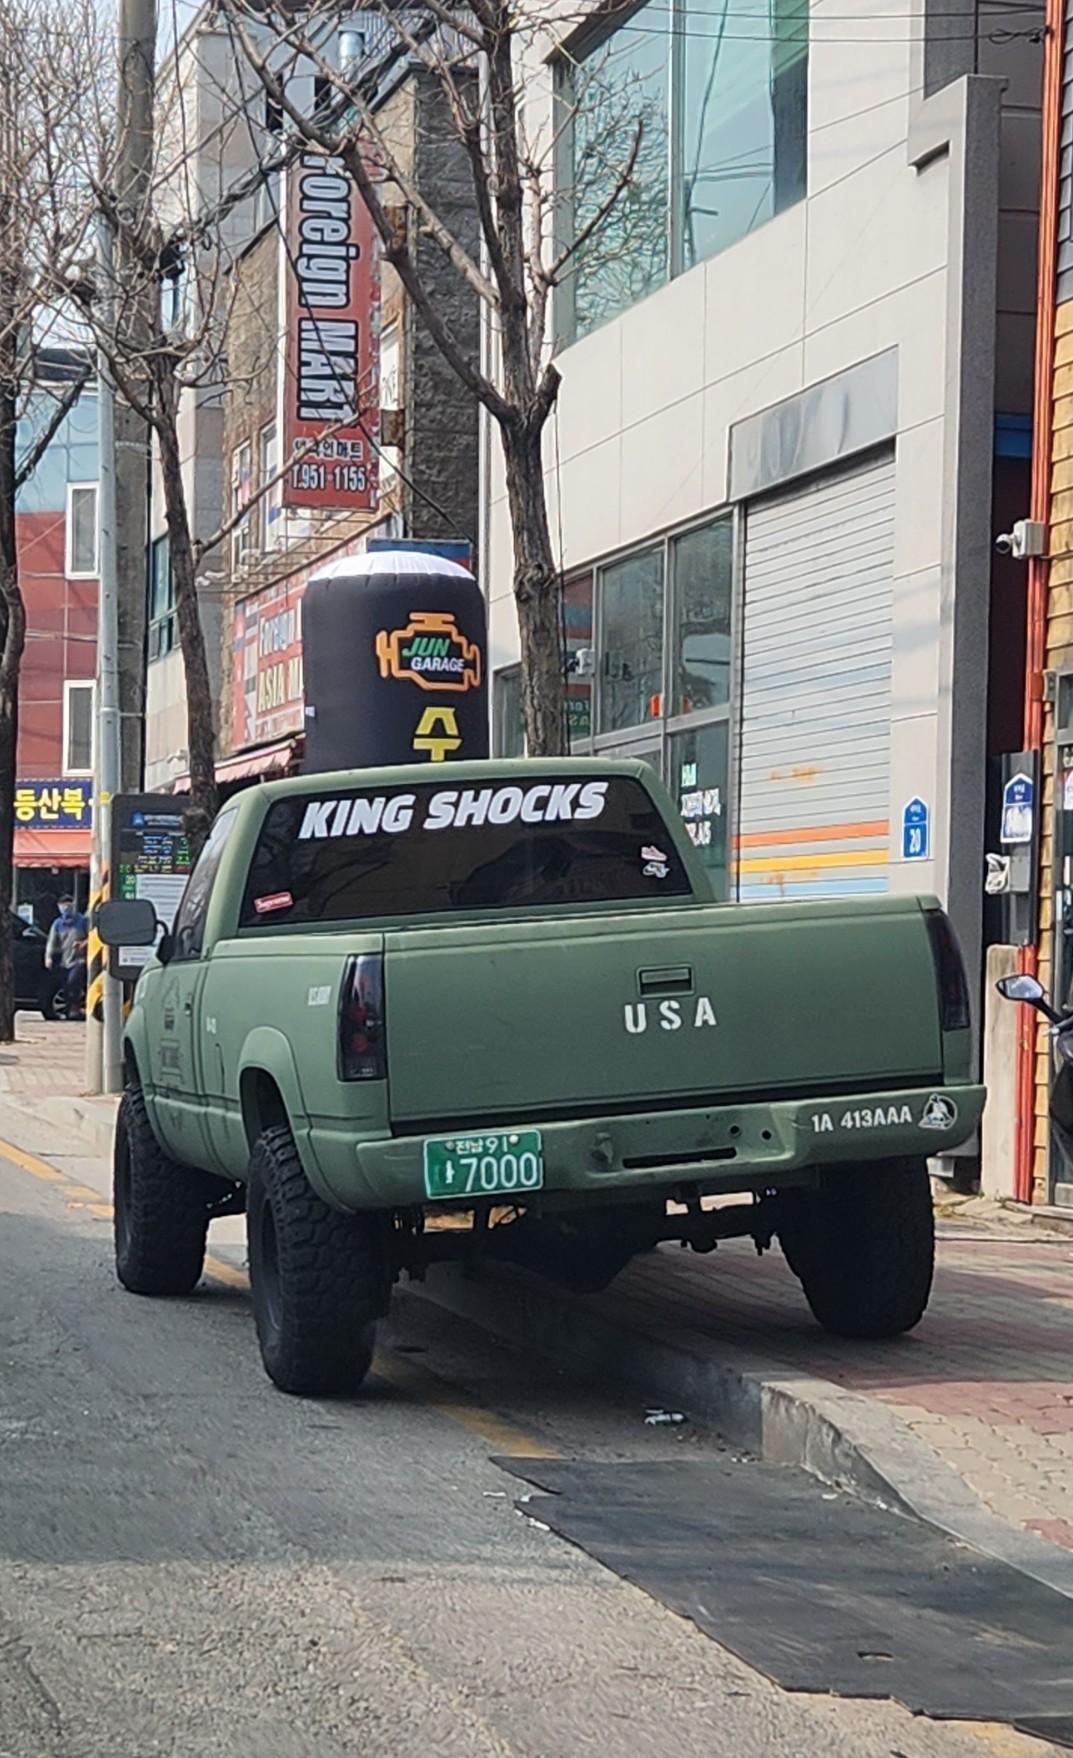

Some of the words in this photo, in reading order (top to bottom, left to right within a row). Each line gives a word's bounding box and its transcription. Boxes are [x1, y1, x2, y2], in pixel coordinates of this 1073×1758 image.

[402, 637, 451, 657] JUN
[411, 656, 465, 672] GARAGE
[298, 795, 416, 839] KING
[423, 782, 609, 830] SHOCKS
[811, 1113, 834, 1133] 1A
[840, 1105, 912, 1129] 413AAA
